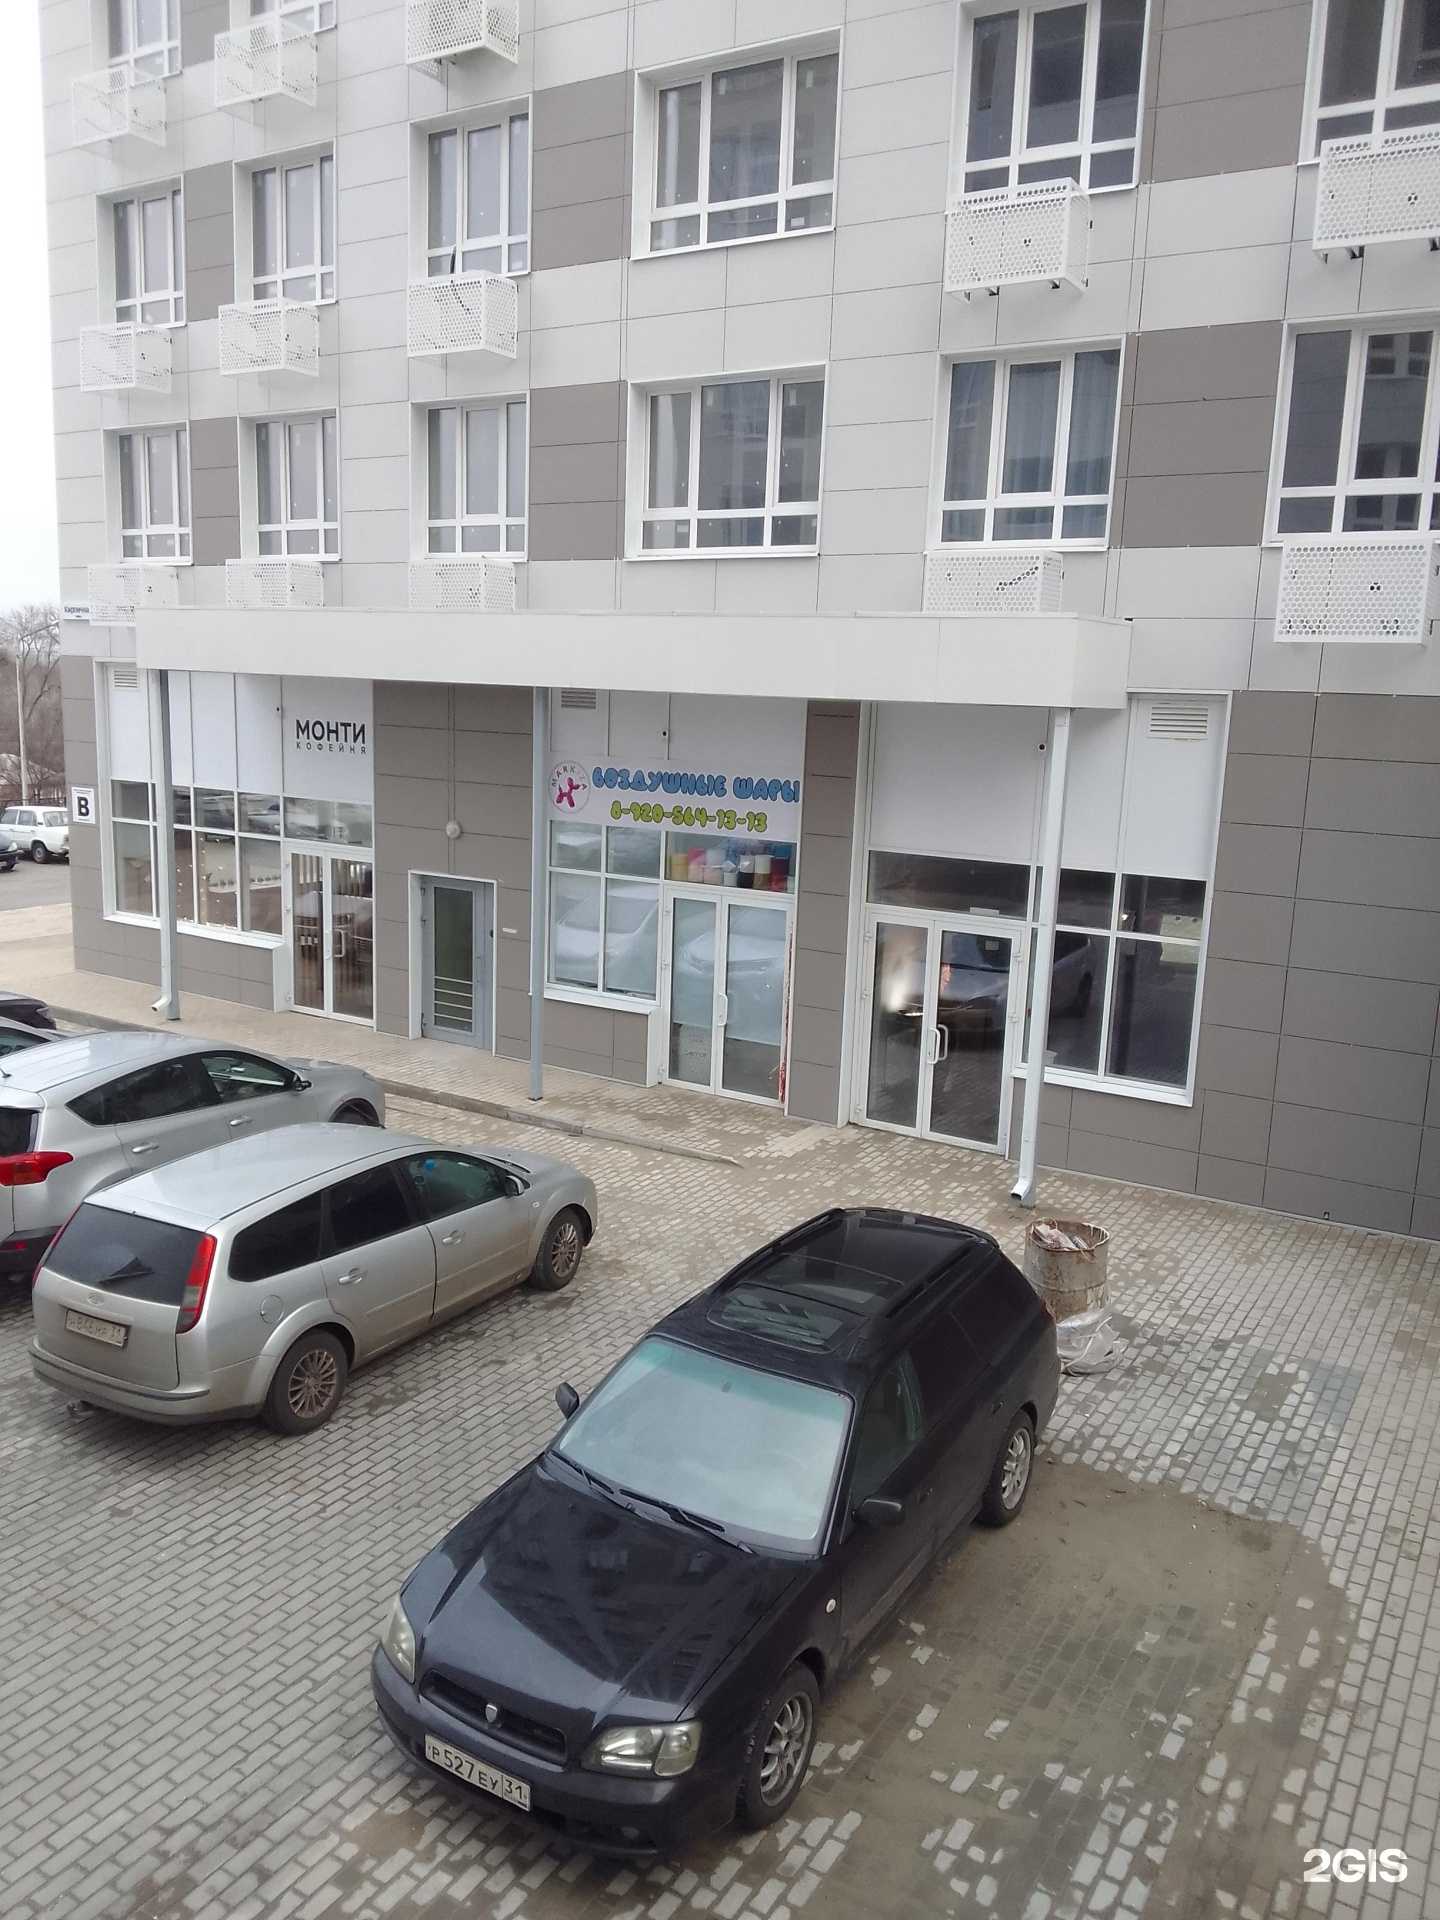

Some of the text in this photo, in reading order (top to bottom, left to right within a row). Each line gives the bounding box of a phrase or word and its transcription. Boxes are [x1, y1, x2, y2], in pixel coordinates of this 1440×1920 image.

[296, 719, 366, 744] МОНТИ
[296, 741, 367, 755] КОФЕЙНЯ
[592, 766, 800, 803] ВОЗДУШНЫЕ ШАРЫ
[77, 796, 90, 816] В
[610, 800, 768, 833] 8-920-564-13-13
